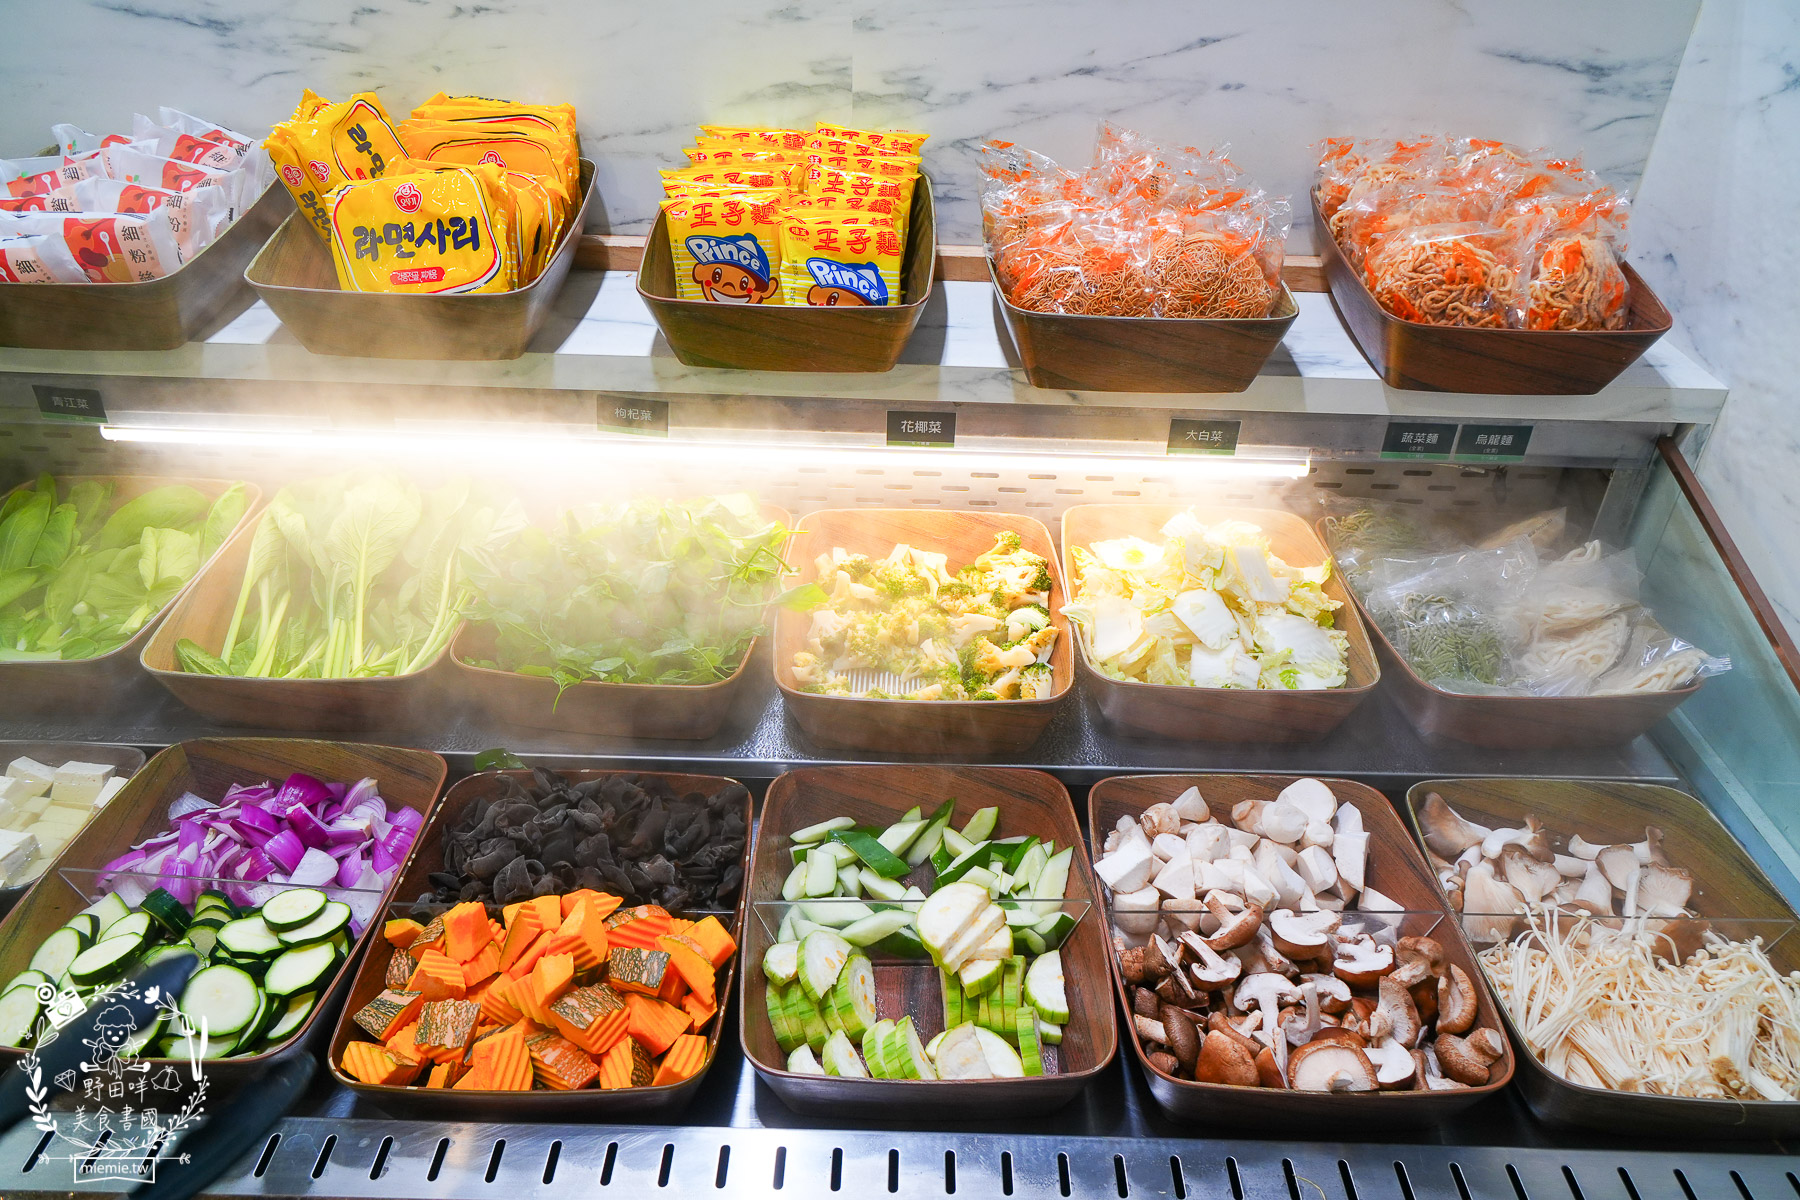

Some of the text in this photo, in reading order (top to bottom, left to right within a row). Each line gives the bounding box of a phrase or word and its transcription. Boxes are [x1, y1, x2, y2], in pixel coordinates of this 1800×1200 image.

[822, 172, 902, 200] 王子麵
[690, 201, 778, 229] 王子麵
[353, 216, 480, 262] 라면사리
[814, 228, 900, 256] 王子麵
[687, 238, 761, 271] Prince
[809, 260, 881, 302] Prince
[900, 420, 942, 434] 花椰菜
[1185, 429, 1224, 442] 大白菜
[1400, 432, 1440, 445] 蔬菜麵
[1475, 434, 1515, 446] 烏龍麵
